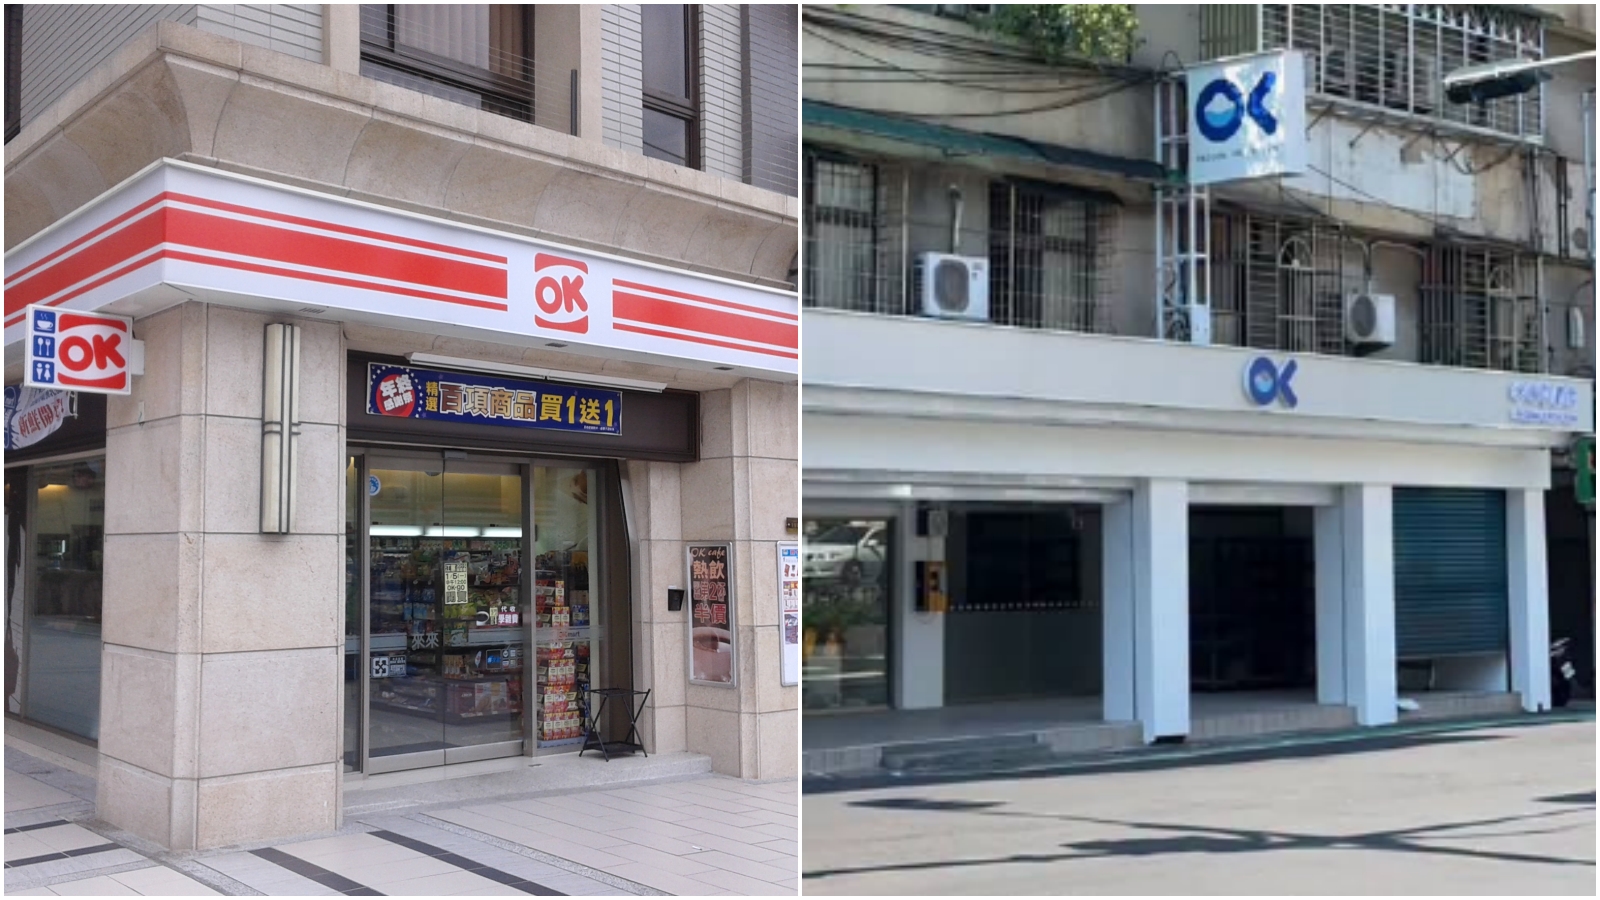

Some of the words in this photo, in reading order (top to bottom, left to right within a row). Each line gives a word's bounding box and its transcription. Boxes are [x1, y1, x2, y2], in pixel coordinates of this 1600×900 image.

[1196, 71, 1277, 143] OK
[535, 275, 588, 314] OK
[58, 333, 126, 372] OK
[1248, 357, 1298, 408] OK
[439, 381, 537, 422] 百項商品
[539, 394, 613, 427] 買1送1
[693, 560, 725, 580] 熱飲
[694, 602, 727, 625] 半價
